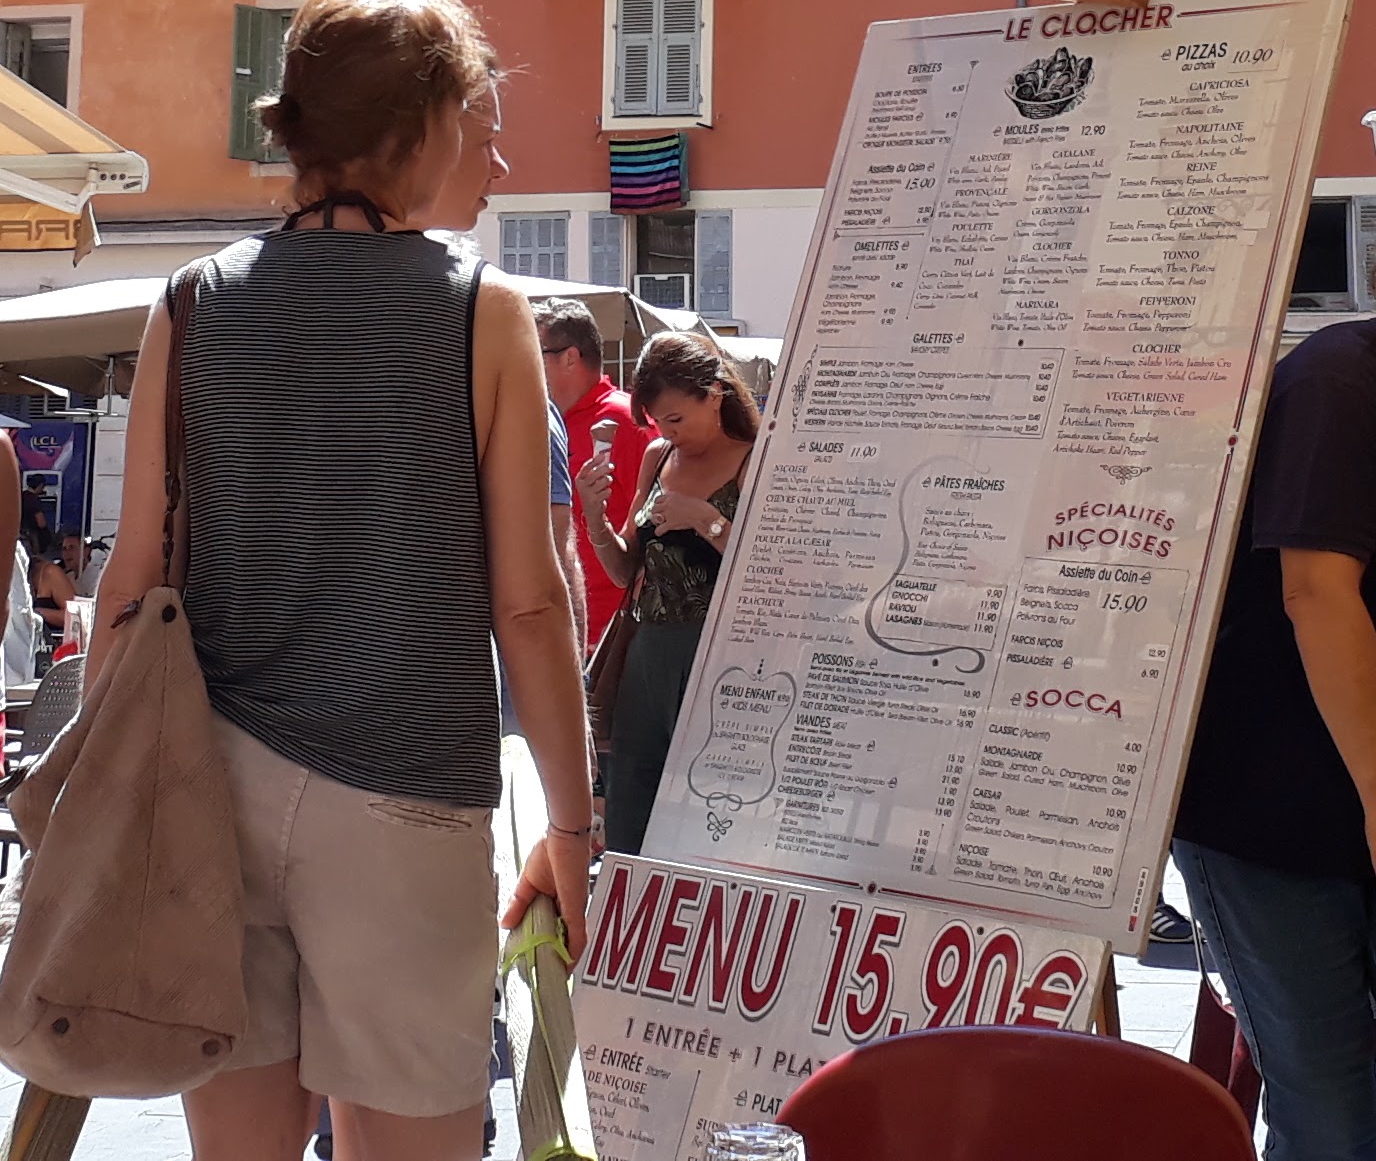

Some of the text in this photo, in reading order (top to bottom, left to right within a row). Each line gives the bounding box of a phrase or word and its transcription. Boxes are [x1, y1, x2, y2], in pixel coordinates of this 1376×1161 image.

[1003, 4, 1174, 42] LE CLOCHER
[1175, 42, 1228, 61] PIZZAS
[1189, 79, 1249, 91] CAPRICIOSA
[1005, 124, 1039, 135] MOULES
[1081, 125, 1106, 136] 12.90
[1176, 122, 1244, 134] NAPOLITAINE
[1186, 162, 1217, 172] REINE
[1167, 206, 1215, 216] CALZONE
[1163, 251, 1200, 260] TONNO
[1139, 296, 1197, 306] PEPPERONI
[913, 333, 953, 343] GALETTES
[1132, 344, 1182, 353] CLOCHER
[33, 436, 58, 446] LCL
[809, 442, 844, 453] SALADES
[934, 475, 1006, 491] PÂTES FRAÎCHES
[1055, 501, 1175, 532] SPÉCIALITÉS
[1047, 528, 1172, 558] NIÇOISES
[1059, 565, 1138, 583] Assiette du Coin
[892, 591, 928, 602] GNOCCHI
[886, 614, 923, 625] LASAGNES
[812, 652, 854, 668] POISSONS
[720, 685, 777, 701] MENU ENFANT
[1025, 689, 1123, 721] SOCCA
[796, 713, 831, 728] VIANDES
[989, 724, 1019, 736] CLASSIC
[983, 745, 1043, 761] MONTAGNARDE
[973, 788, 1002, 800] CAESAR
[582, 861, 806, 1022] MENU
[643, 1021, 723, 1059] ENTRÉE
[754, 1047, 762, 1067] 1
[600, 1048, 644, 1073] ENTRÉE
[603, 1074, 647, 1094] NIÇOISE
[752, 1093, 782, 1115] PLAT
